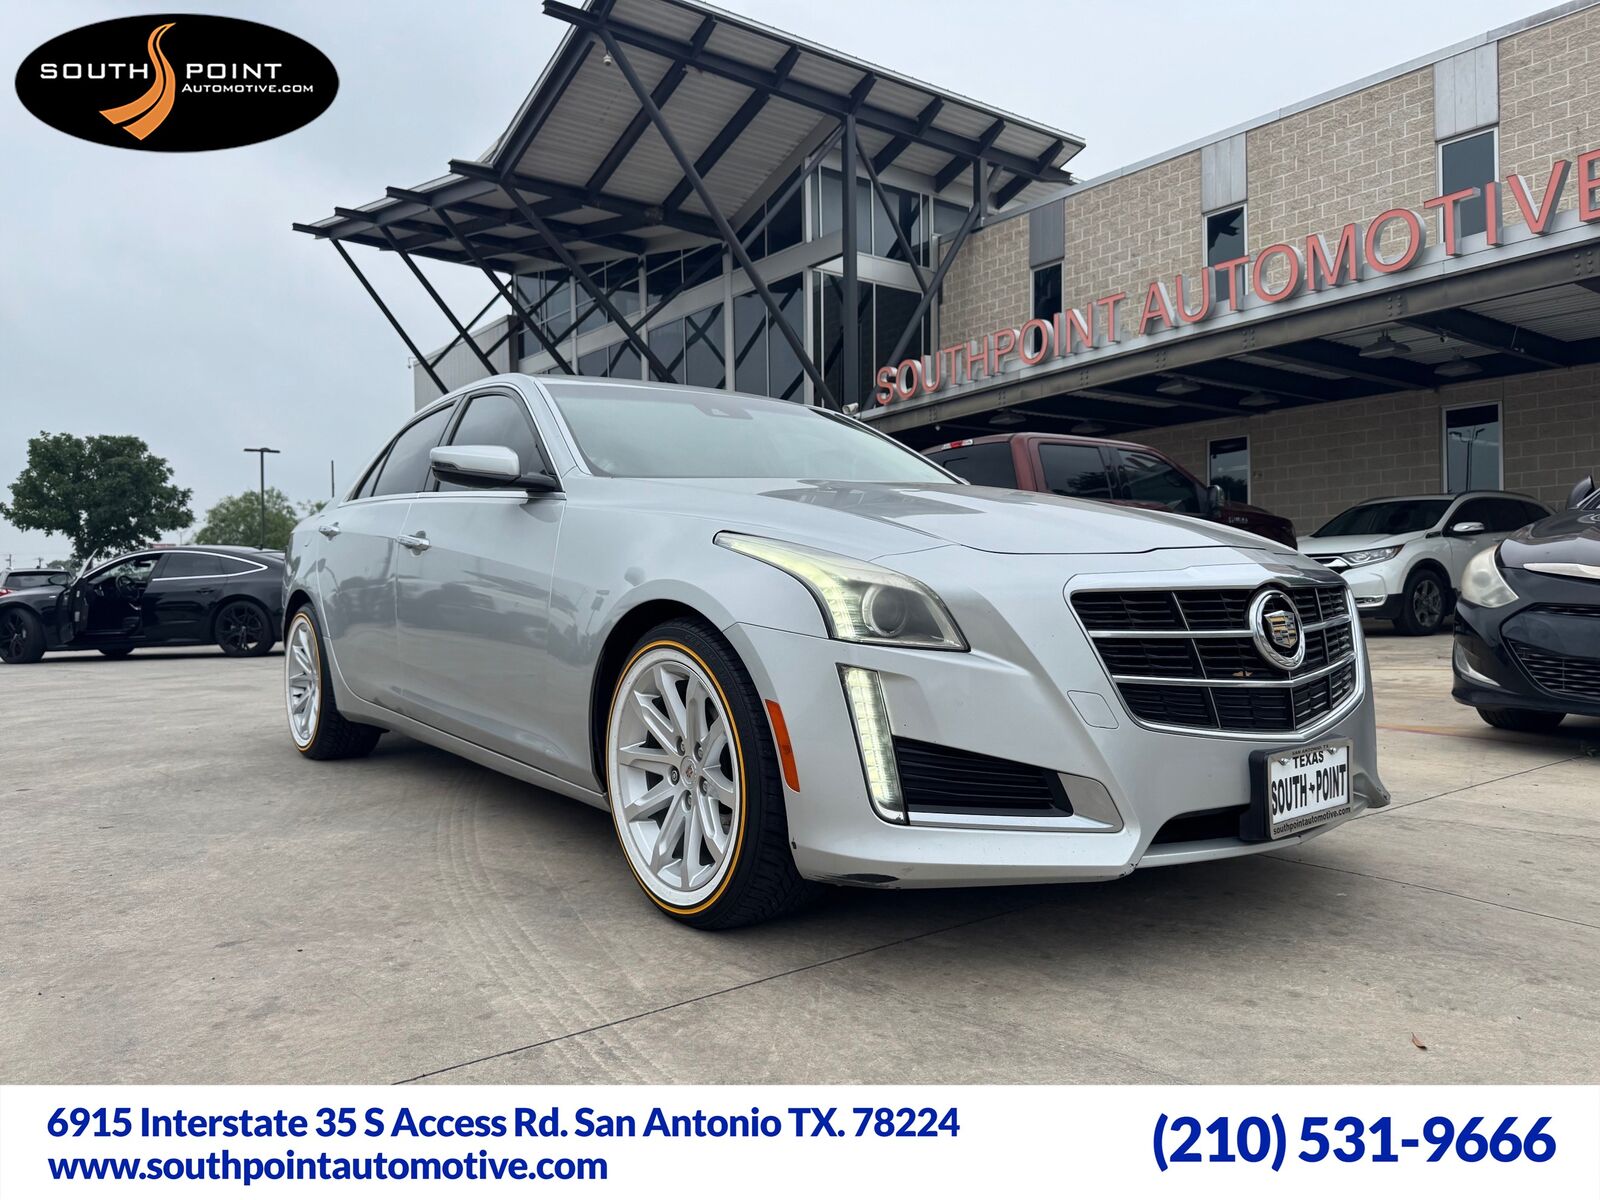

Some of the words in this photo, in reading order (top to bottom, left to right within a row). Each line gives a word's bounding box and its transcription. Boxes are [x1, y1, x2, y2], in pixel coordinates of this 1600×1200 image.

[876, 291, 1127, 406] SOUTHPOINT
[1293, 750, 1324, 769] TEXAS
[1271, 773, 1307, 816] SOUTH
[1316, 763, 1347, 803] POINT
[1273, 806, 1351, 835] southpointautomotive.com
